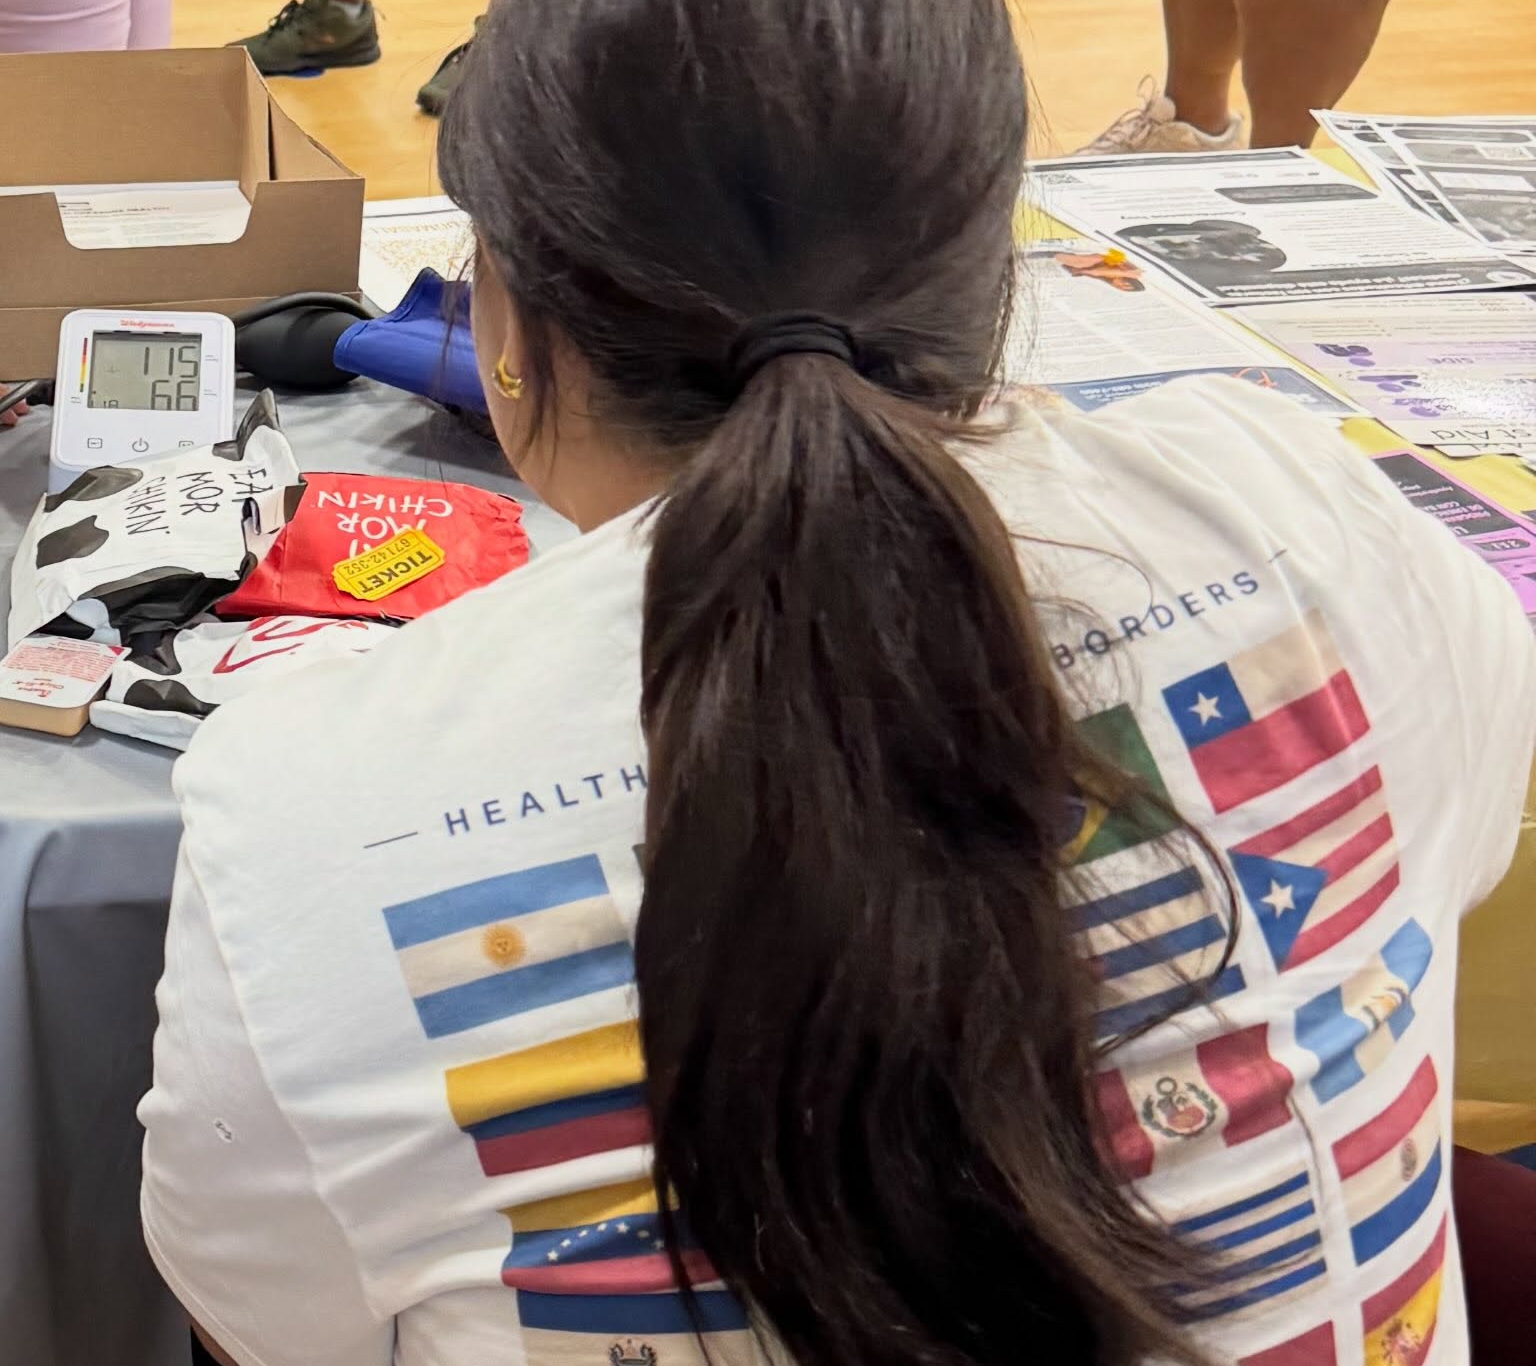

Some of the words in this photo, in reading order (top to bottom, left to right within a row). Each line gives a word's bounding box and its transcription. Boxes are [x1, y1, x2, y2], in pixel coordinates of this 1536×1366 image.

[1431, 430, 1490, 441] Aid
[176, 471, 223, 516] MOR
[317, 491, 453, 517] CHIKIN
[343, 537, 412, 577] 67142-352
[357, 550, 433, 594] TICKET
[1050, 571, 1260, 670] BORDERS
[444, 763, 649, 836] HEALTH
